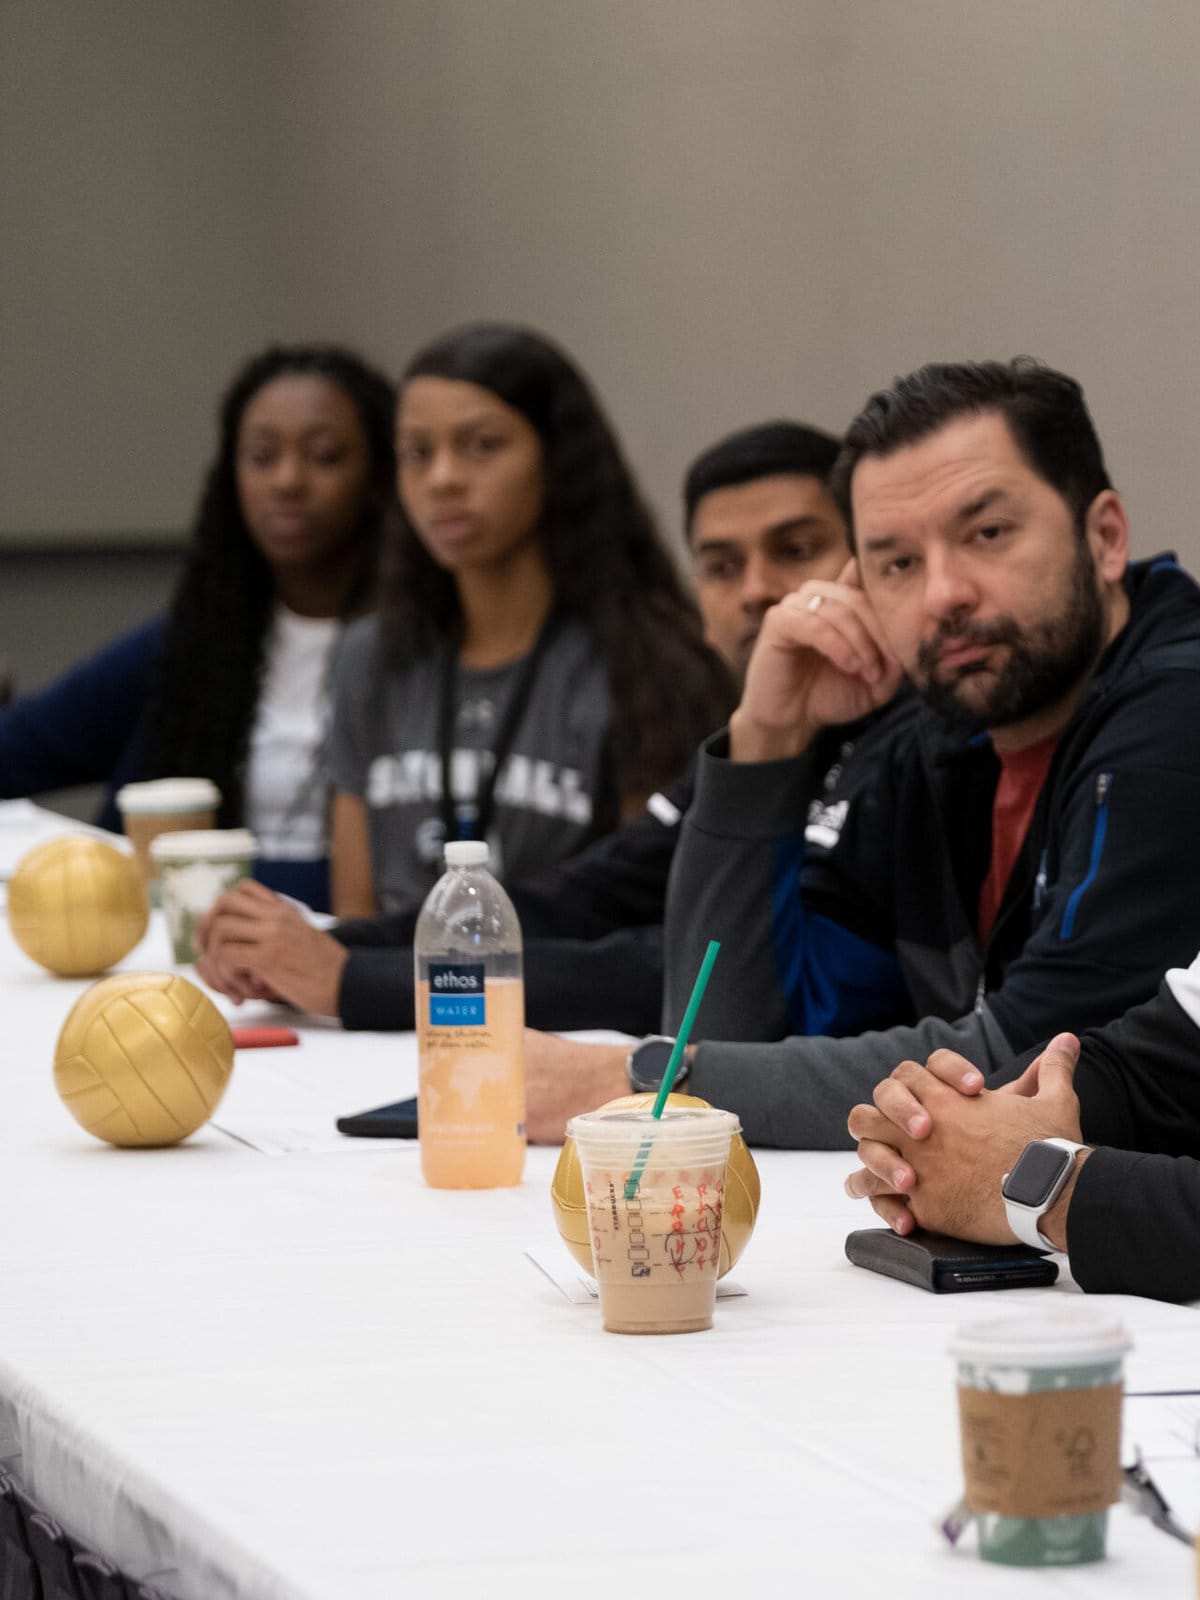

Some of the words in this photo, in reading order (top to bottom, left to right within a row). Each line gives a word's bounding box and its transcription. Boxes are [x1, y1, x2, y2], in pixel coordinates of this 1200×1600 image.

[434, 970, 477, 989] ethos
[435, 1006, 478, 1016] WATER
[609, 1183, 619, 1231] STARBUCKS
